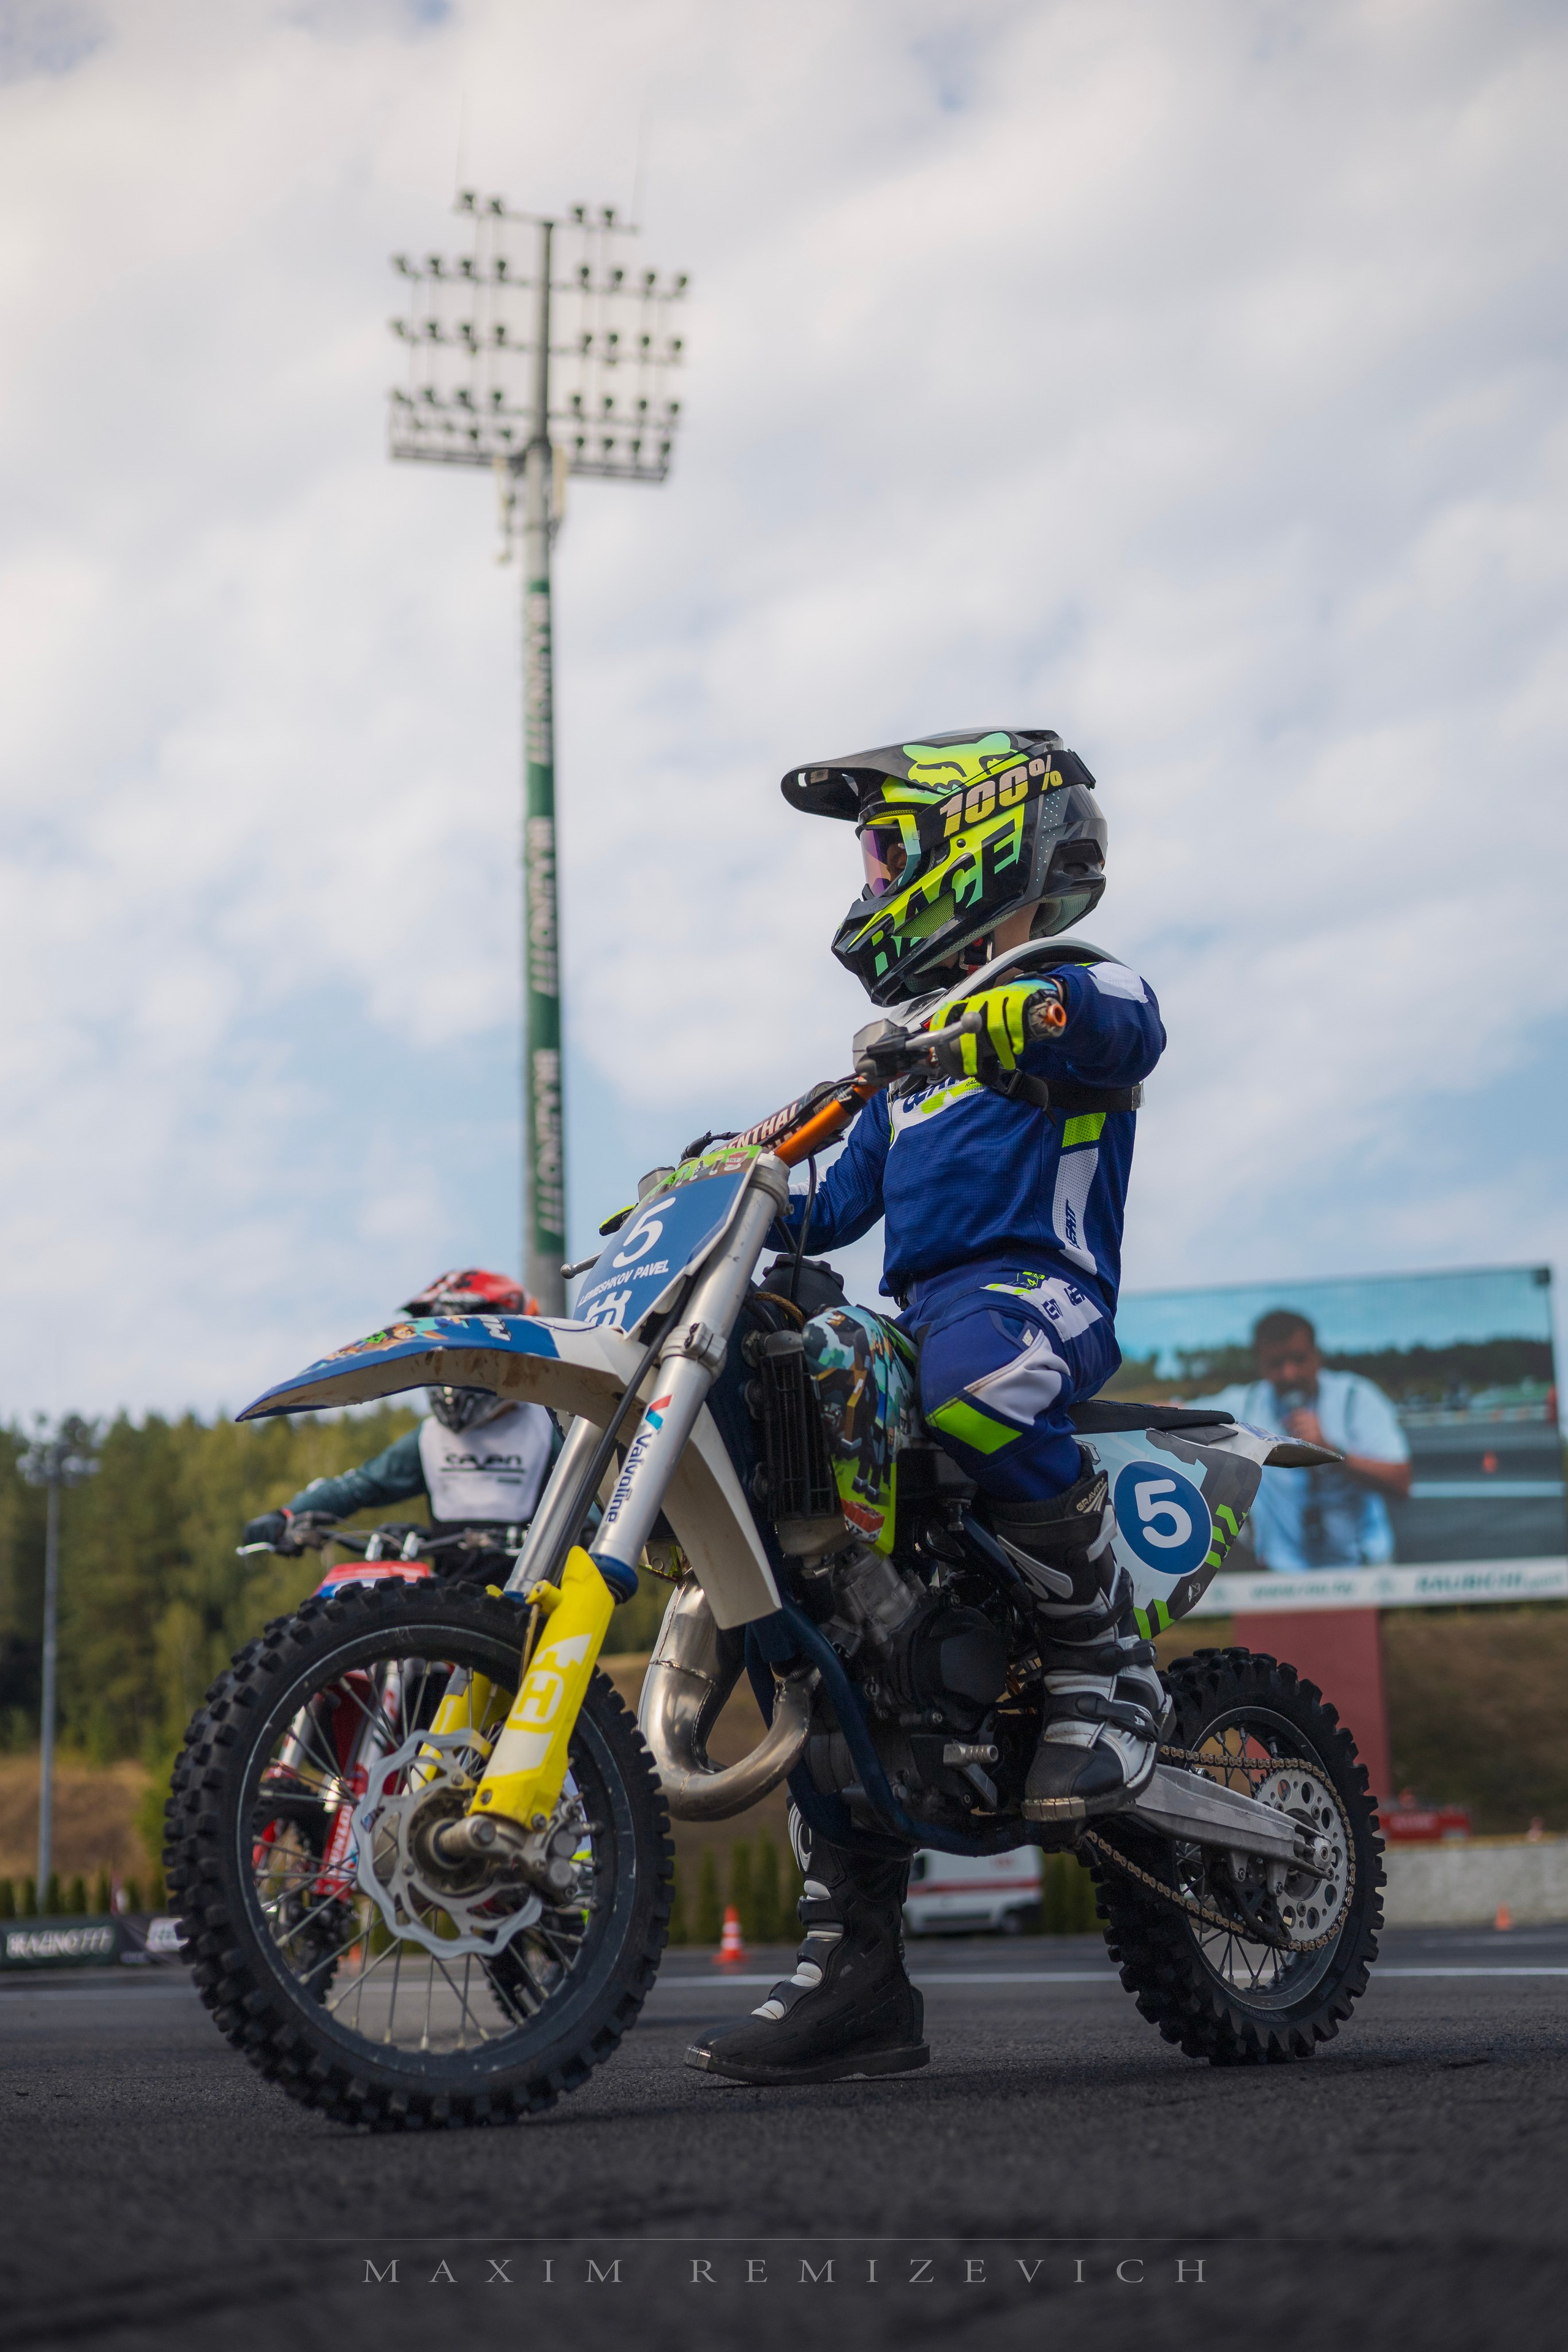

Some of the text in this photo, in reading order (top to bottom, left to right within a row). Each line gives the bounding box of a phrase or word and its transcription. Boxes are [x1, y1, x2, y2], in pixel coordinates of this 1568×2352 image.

[940, 754, 1063, 837] 100%
[862, 818, 1017, 978] RACE
[612, 1196, 676, 1268] 5
[577, 1259, 669, 1308] LEMESHKOV PAVEL
[605, 1433, 652, 1523] Valvoline
[1076, 1477, 1104, 1512] GRAVITY
[1134, 1479, 1193, 1548] 5
